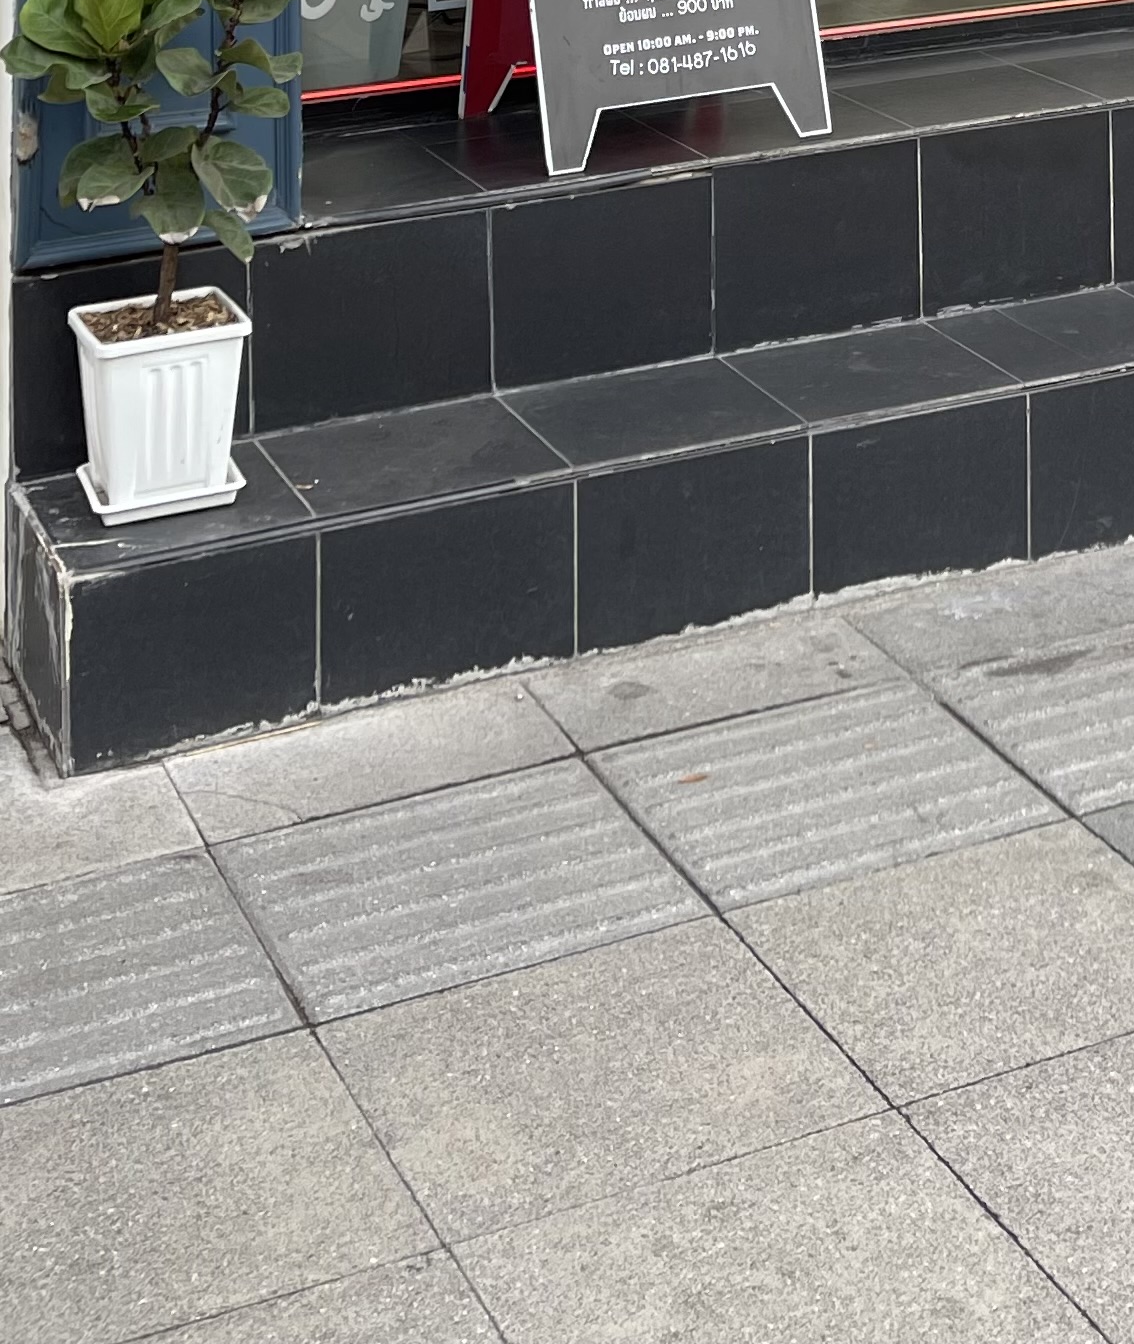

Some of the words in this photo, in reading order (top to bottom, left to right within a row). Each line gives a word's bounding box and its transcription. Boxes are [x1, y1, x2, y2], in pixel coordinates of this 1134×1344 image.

[619, 6, 656, 23] ย้อมผม
[603, 42, 635, 56] OPEN
[637, 36, 671, 51] 10:00
[674, 34, 696, 47] AM.
[706, 27, 735, 42] 9:00
[738, 25, 759, 38] PM.
[609, 59, 634, 76] Tel
[647, 40, 757, 74] 081-487-1616
